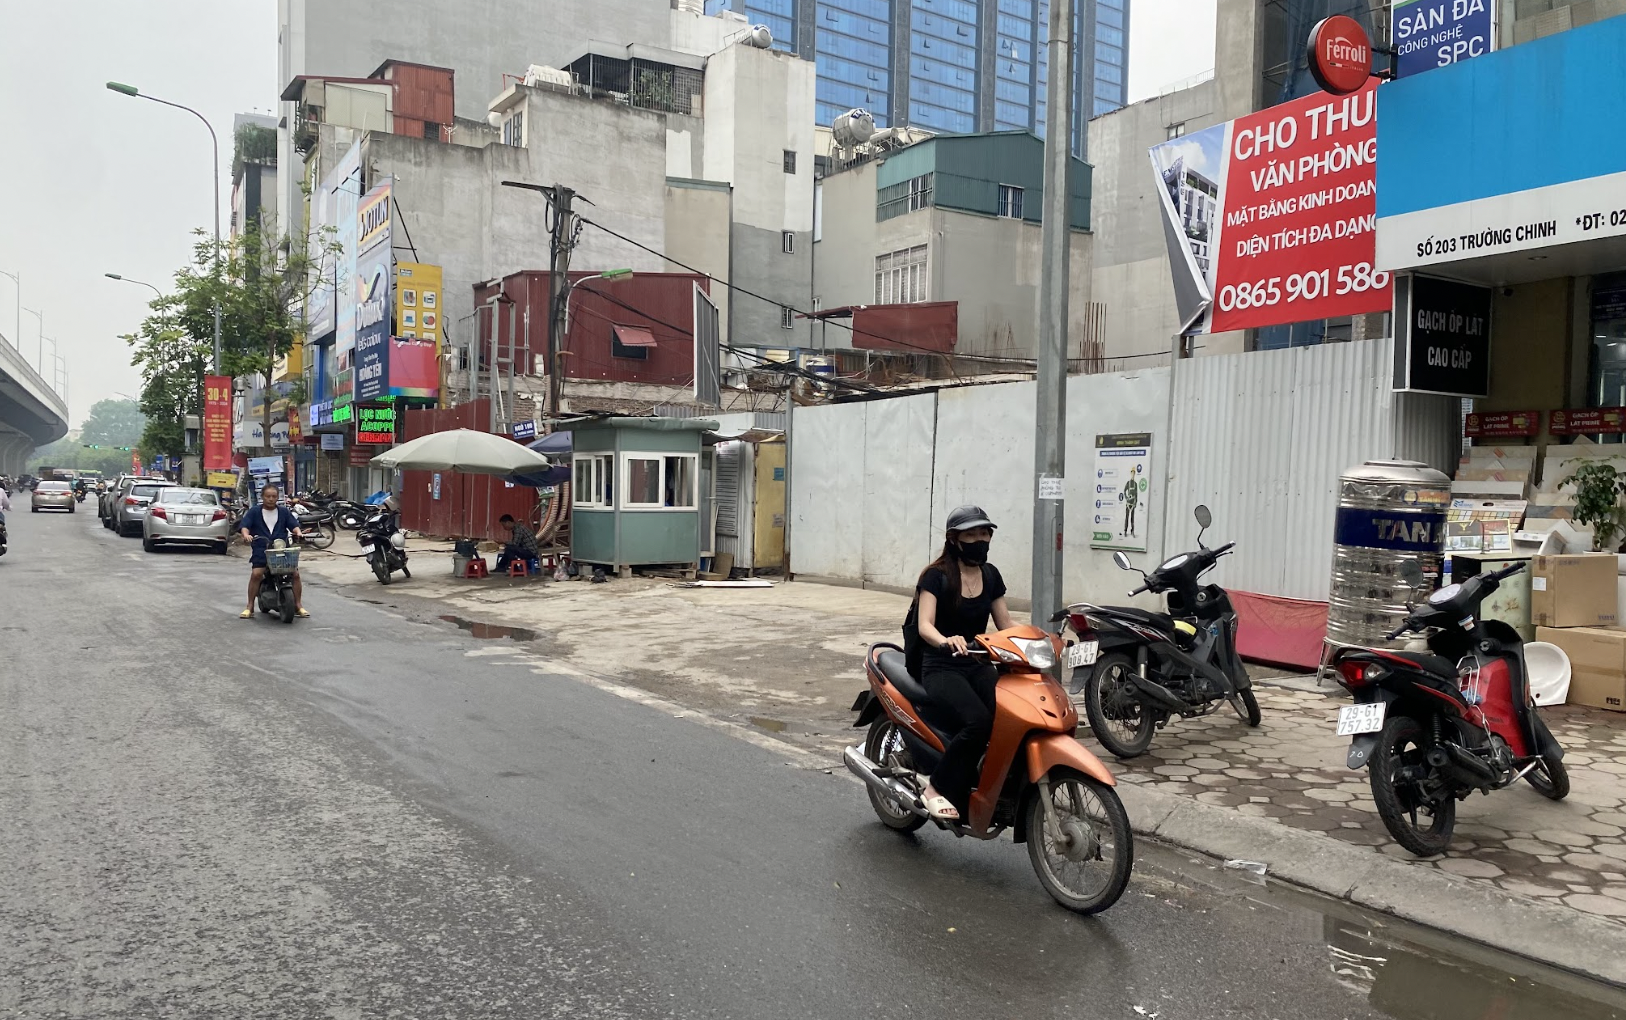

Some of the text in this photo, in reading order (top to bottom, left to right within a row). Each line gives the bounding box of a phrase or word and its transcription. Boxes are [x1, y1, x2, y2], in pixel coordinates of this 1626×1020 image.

[1398, 0, 1485, 38] SÀN ĐA
[1326, 37, 1366, 63] Ferroli
[1397, 24, 1463, 56] CÔNG NGHỆ
[1437, 35, 1484, 67] SPC
[1234, 90, 1377, 161] CHO THU
[1250, 138, 1377, 192] VĂN PHÒNG
[1227, 205, 1257, 227] MẶT
[1259, 198, 1297, 220] BẰNG
[1299, 188, 1334, 212] KINH
[1236, 234, 1270, 258] DIỆN
[1272, 227, 1307, 251] TÍCH
[1308, 223, 1333, 244] ĐA
[1417, 235, 1434, 258] SỐ
[1435, 238, 1457, 255] 203
[1460, 227, 1512, 251] TRƯỜNG
[1515, 220, 1557, 242] CHINH
[1610, 209, 1626, 226] 02
[1219, 262, 1390, 312] 0865 901 586
[1417, 309, 1446, 334] GẠCH
[1427, 343, 1472, 369] CAO CẤP
[359, 408, 374, 421] LỌC
[1071, 642, 1093, 656] 29-G1
[1340, 717, 1380, 734] 757.32
[1345, 704, 1378, 720] 29-G1
